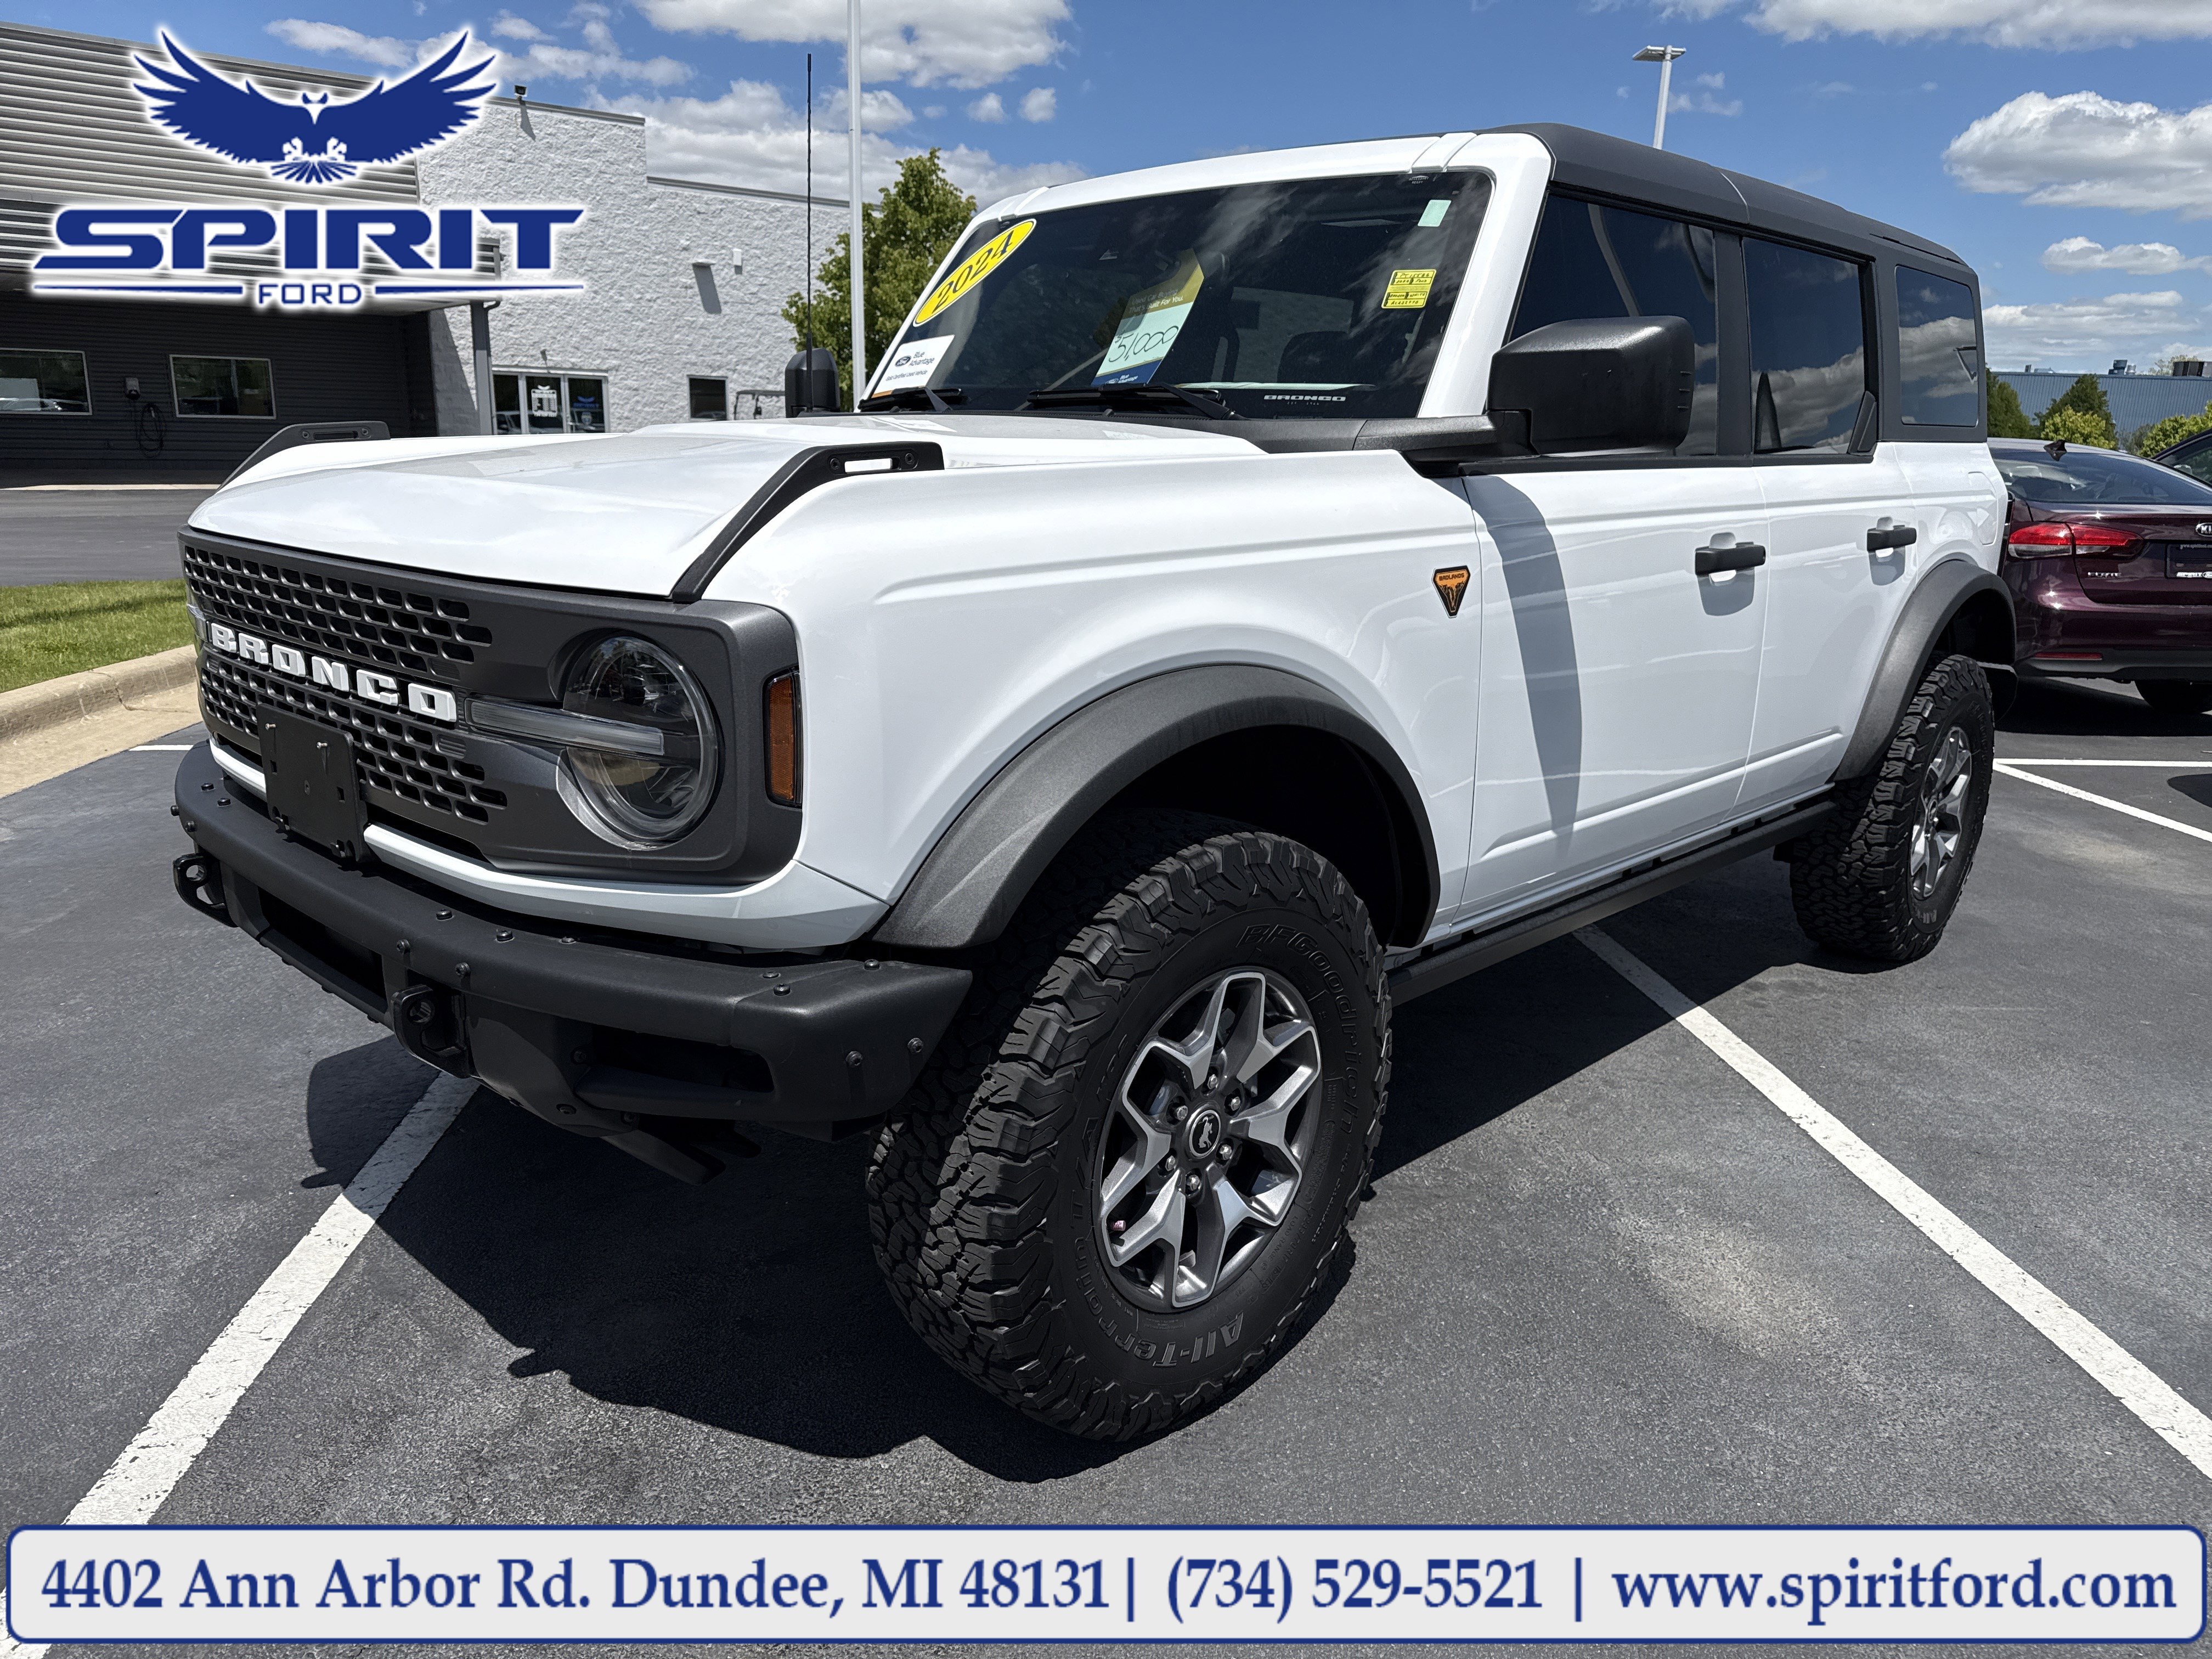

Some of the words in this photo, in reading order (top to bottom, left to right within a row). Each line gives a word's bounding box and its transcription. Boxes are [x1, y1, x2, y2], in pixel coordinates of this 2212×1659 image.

[931, 229, 1014, 314] 2024
[2200, 524, 2212, 534] KI
[1438, 573, 1465, 581] BADLANDS
[211, 622, 457, 723] BRONCO
[1235, 923, 1362, 1134] BFGoodrich
[1075, 1237, 1244, 1367] All-Terrain
